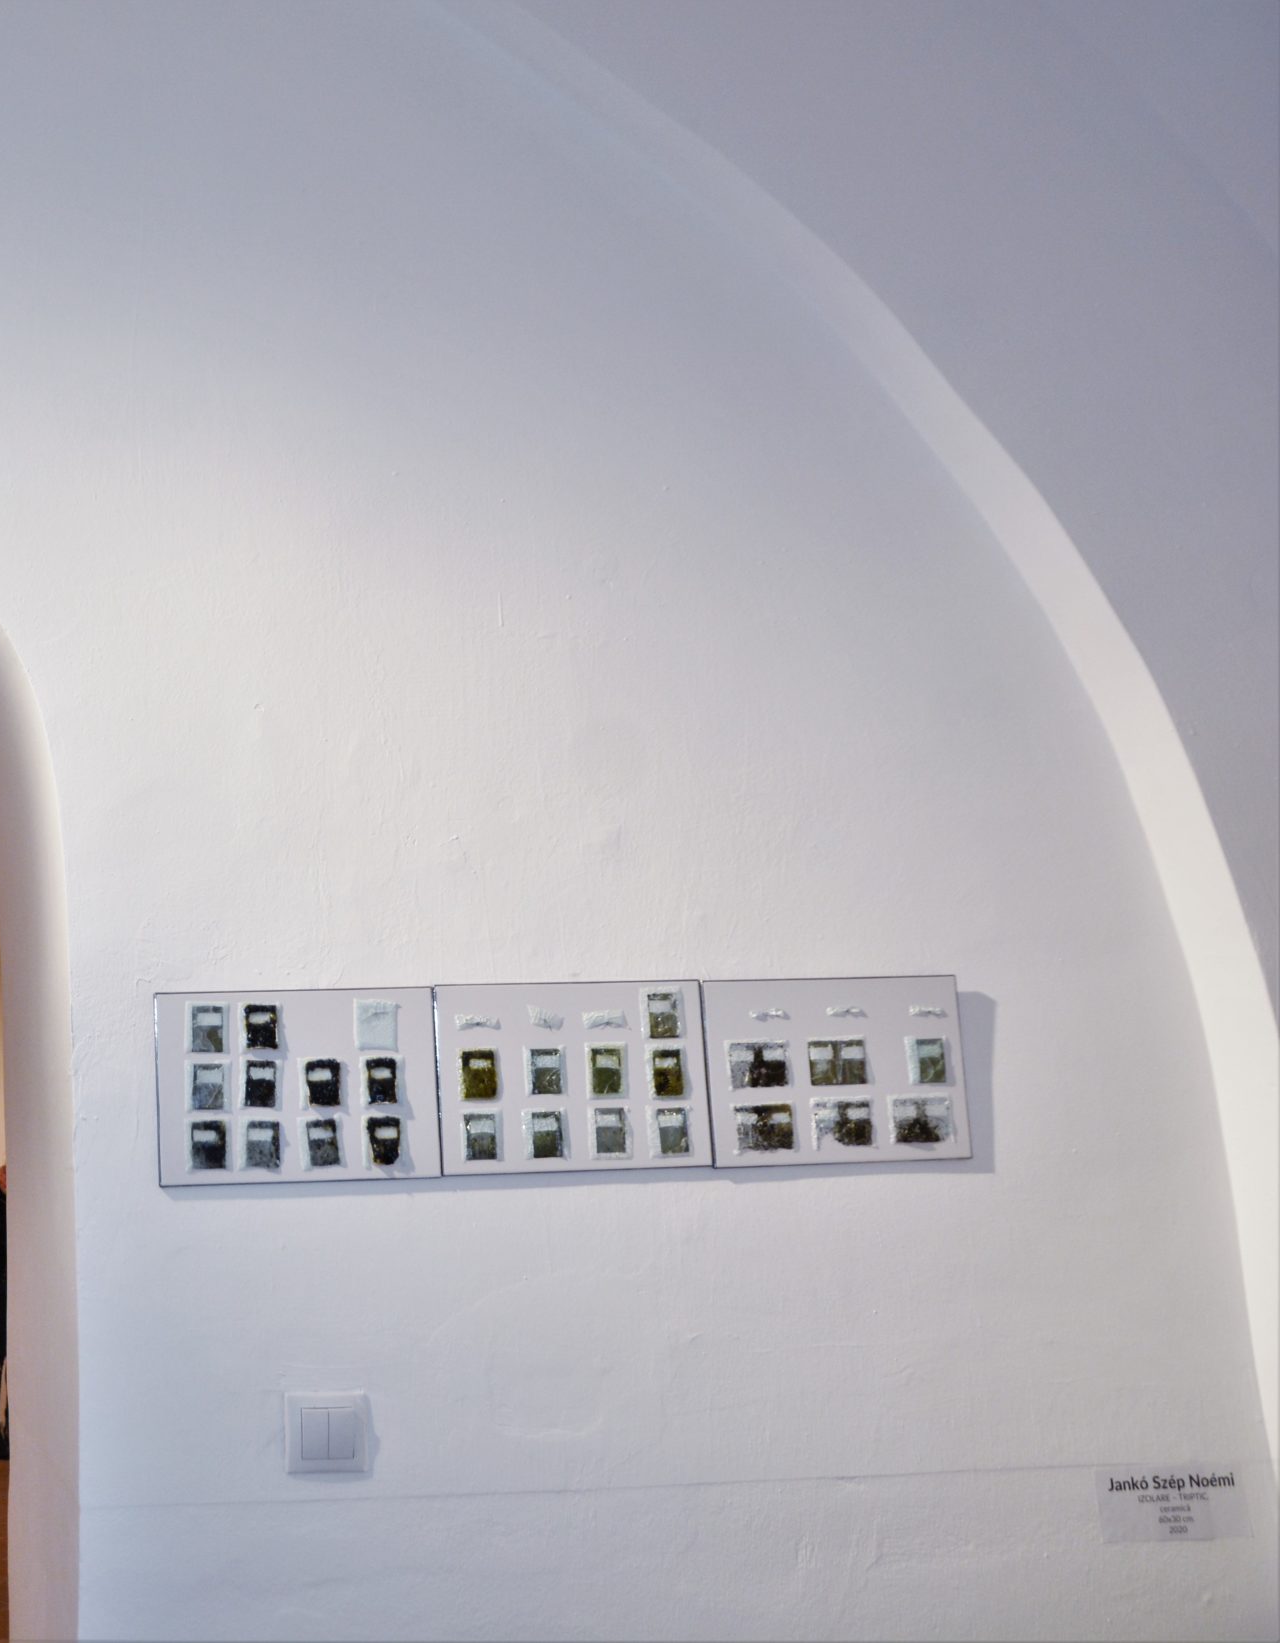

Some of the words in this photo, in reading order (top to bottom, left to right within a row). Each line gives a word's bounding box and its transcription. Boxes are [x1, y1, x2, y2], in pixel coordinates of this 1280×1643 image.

[1108, 1476, 1149, 1492] Jankó
[1152, 1475, 1185, 1491] Szép
[1189, 1472, 1235, 1488] Noémi
[1137, 1493, 1171, 1503] IZOLARE
[1169, 1525, 1188, 1534] 2020
